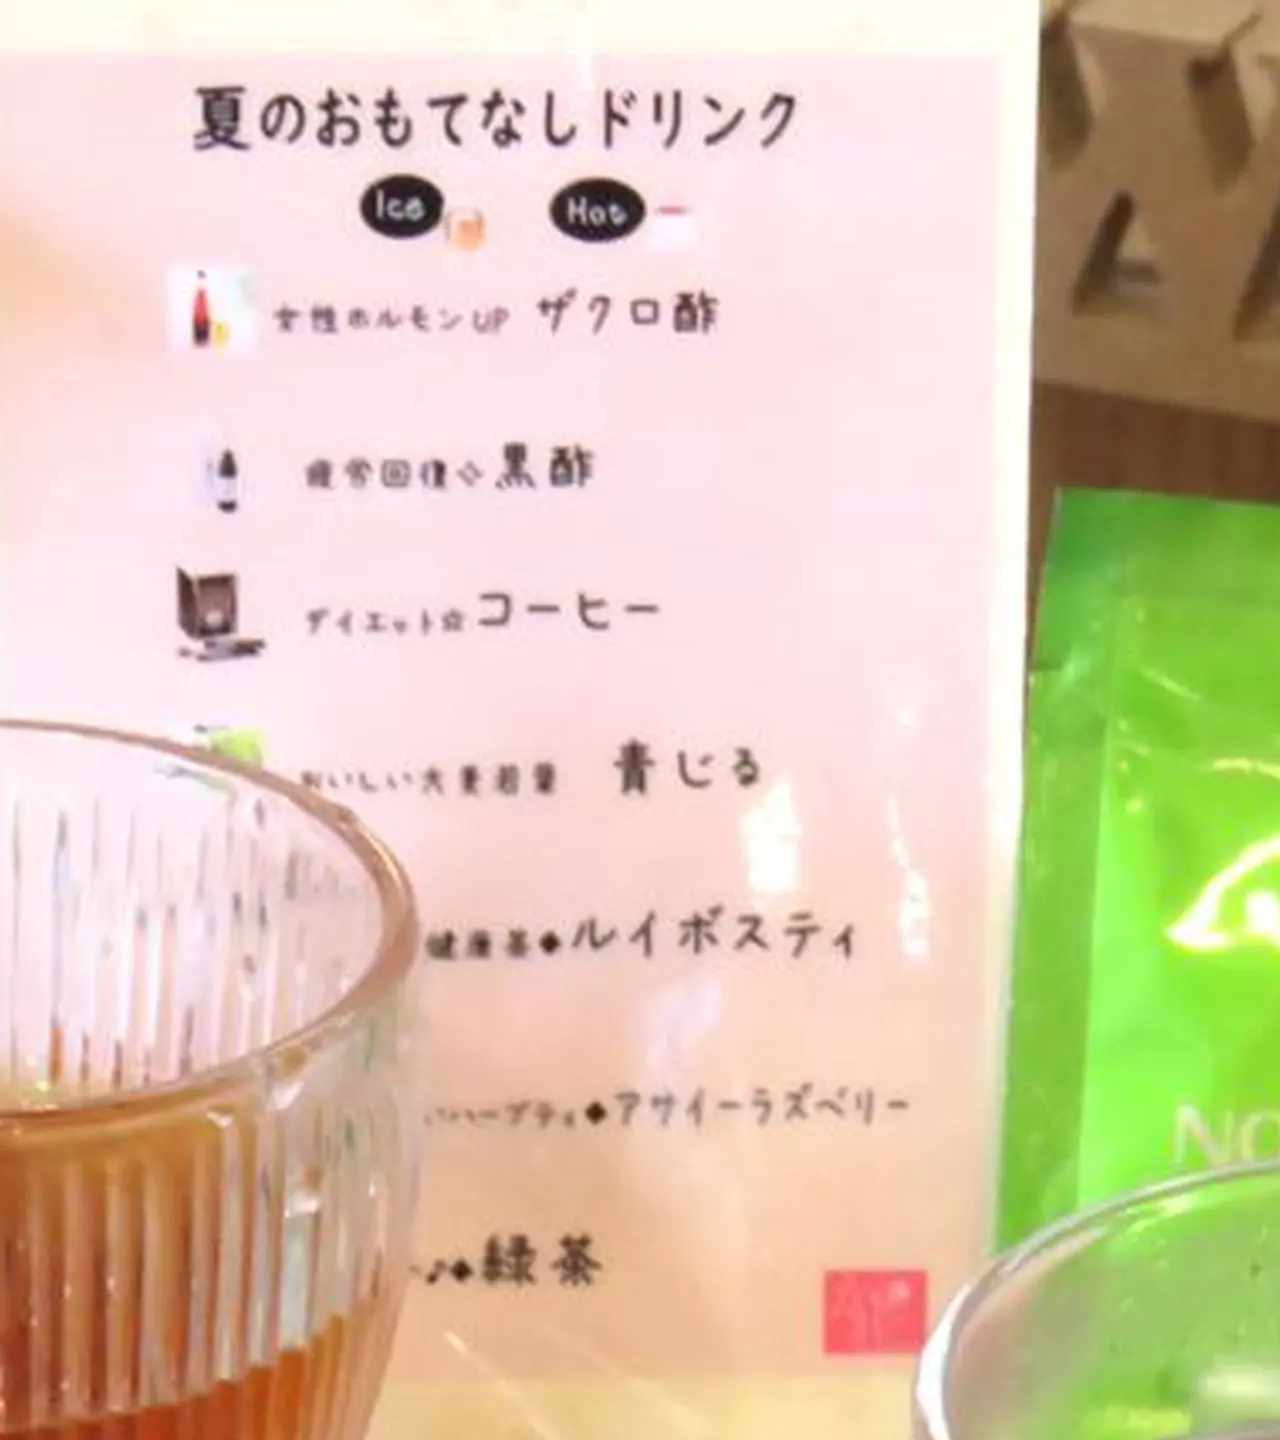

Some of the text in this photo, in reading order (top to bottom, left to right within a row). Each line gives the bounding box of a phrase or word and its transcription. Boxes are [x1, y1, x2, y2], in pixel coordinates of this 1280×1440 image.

[193, 85, 798, 151] 夏のおもてなしドリンク
[568, 193, 627, 227] Hot
[536, 288, 719, 335] ザクロ酢
